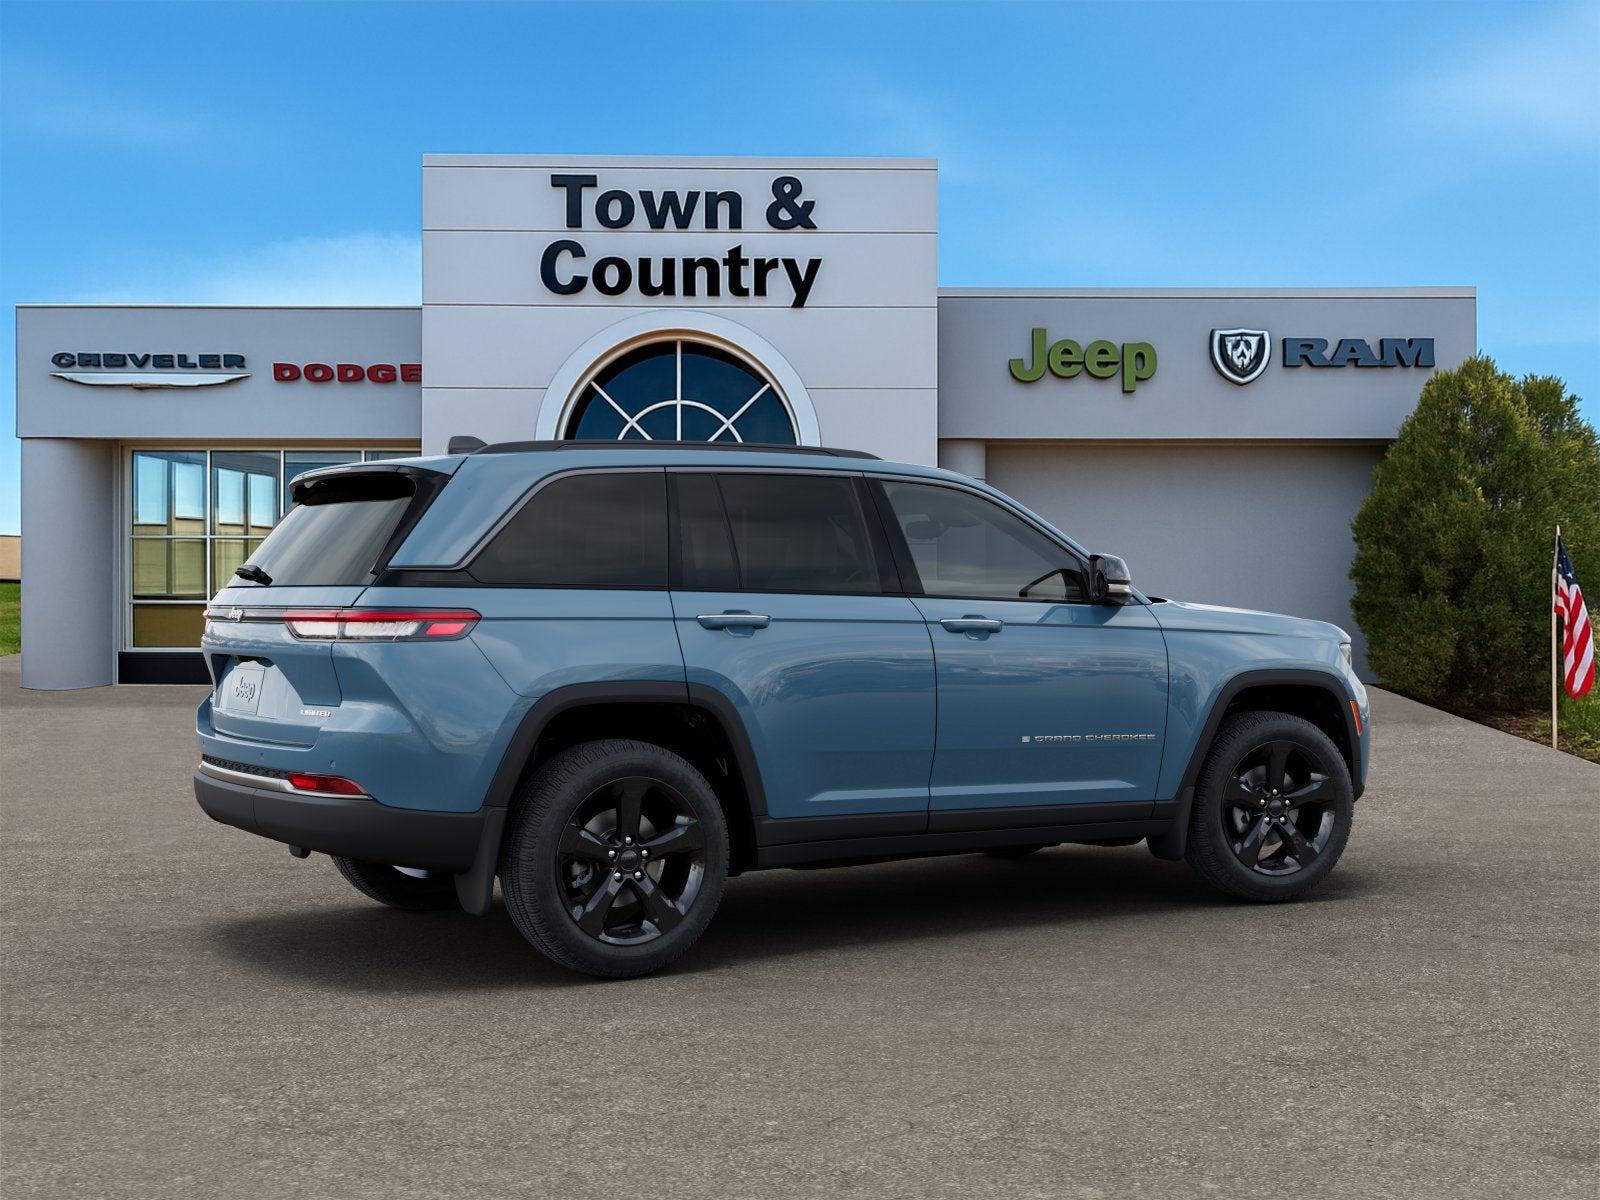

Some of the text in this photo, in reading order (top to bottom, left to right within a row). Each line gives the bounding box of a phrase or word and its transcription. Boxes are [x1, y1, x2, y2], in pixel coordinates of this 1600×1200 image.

[550, 174, 818, 230] Town &
[540, 239, 823, 308] Country
[273, 363, 422, 383] DODGE
[1008, 327, 1158, 394] Jeep
[1282, 337, 1436, 368] RAM
[1034, 733, 1156, 742] GRAND CHEROKEE
